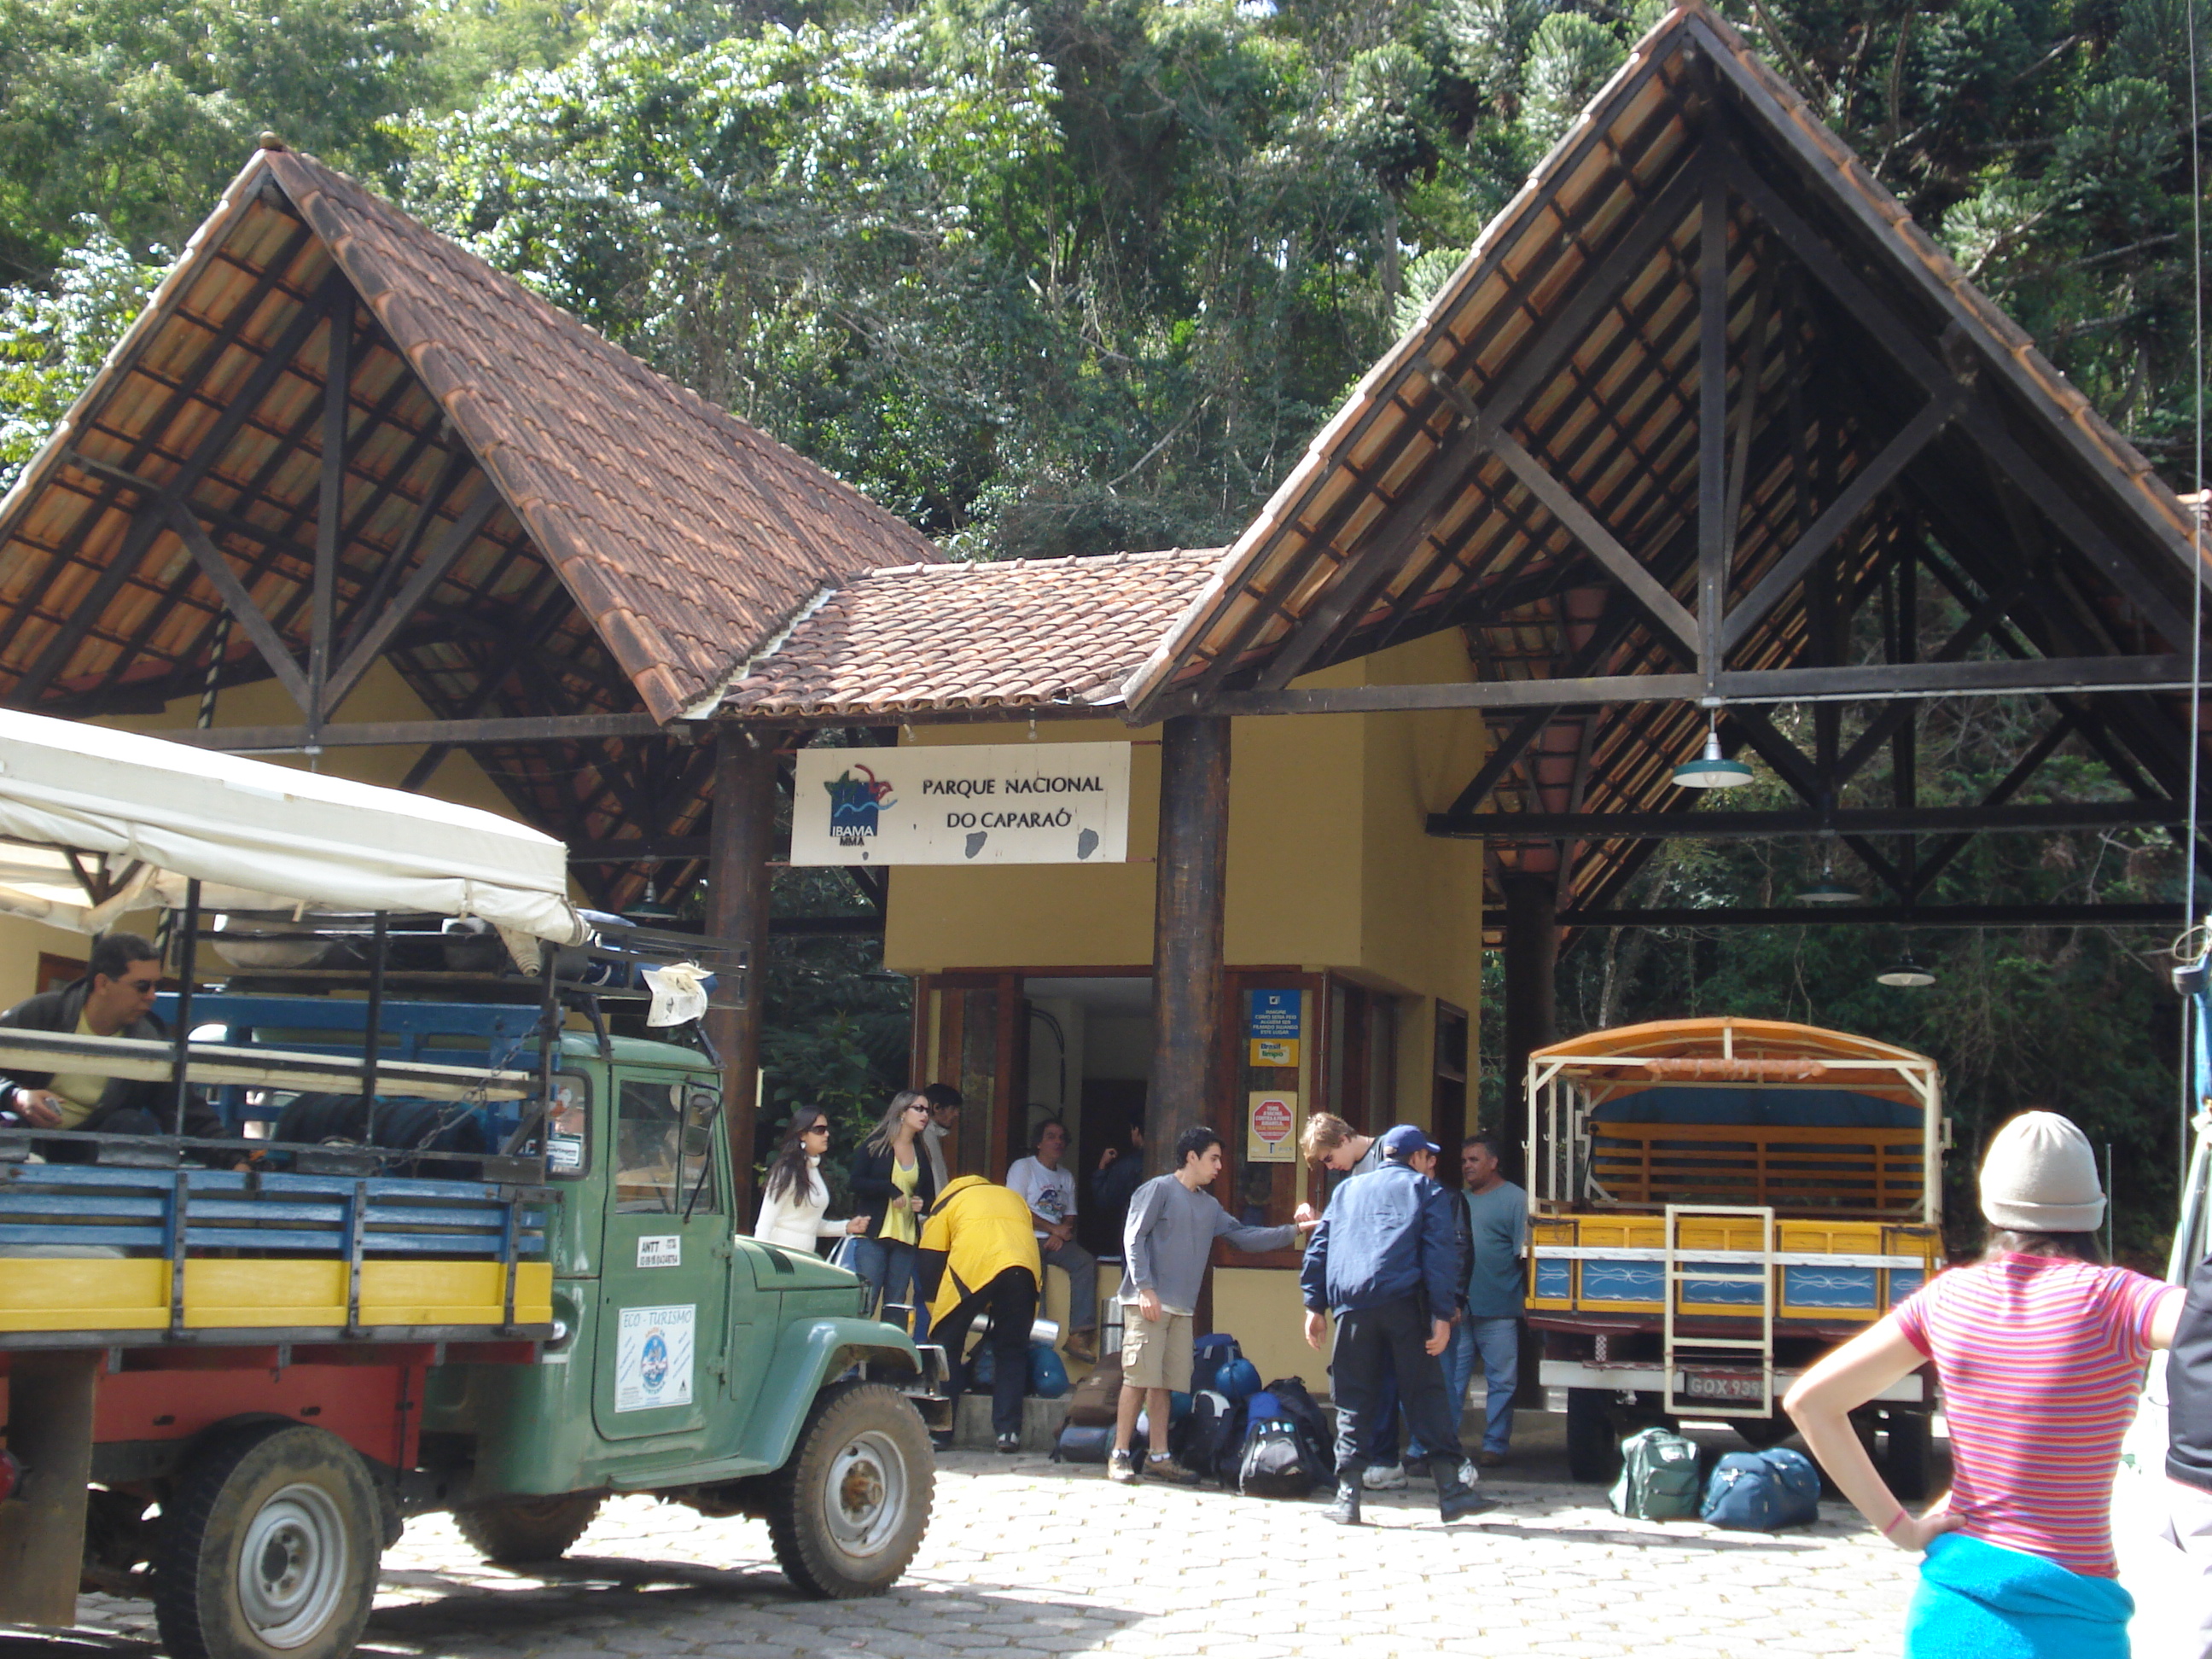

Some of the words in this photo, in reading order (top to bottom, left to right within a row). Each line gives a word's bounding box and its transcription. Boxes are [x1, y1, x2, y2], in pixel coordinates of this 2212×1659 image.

[923, 778, 995, 799] PARQUE
[1005, 777, 1103, 794] NACIONAL
[947, 812, 975, 828] DO
[981, 808, 1072, 828] CAPARAÓ
[831, 825, 874, 837] IBAMA
[839, 836, 864, 847] MMA
[1262, 1051, 1284, 1059] limpo
[624, 1313, 641, 1328] ECO
[649, 1311, 692, 1326] TURISMO
[1691, 1377, 1728, 1395] GOX
